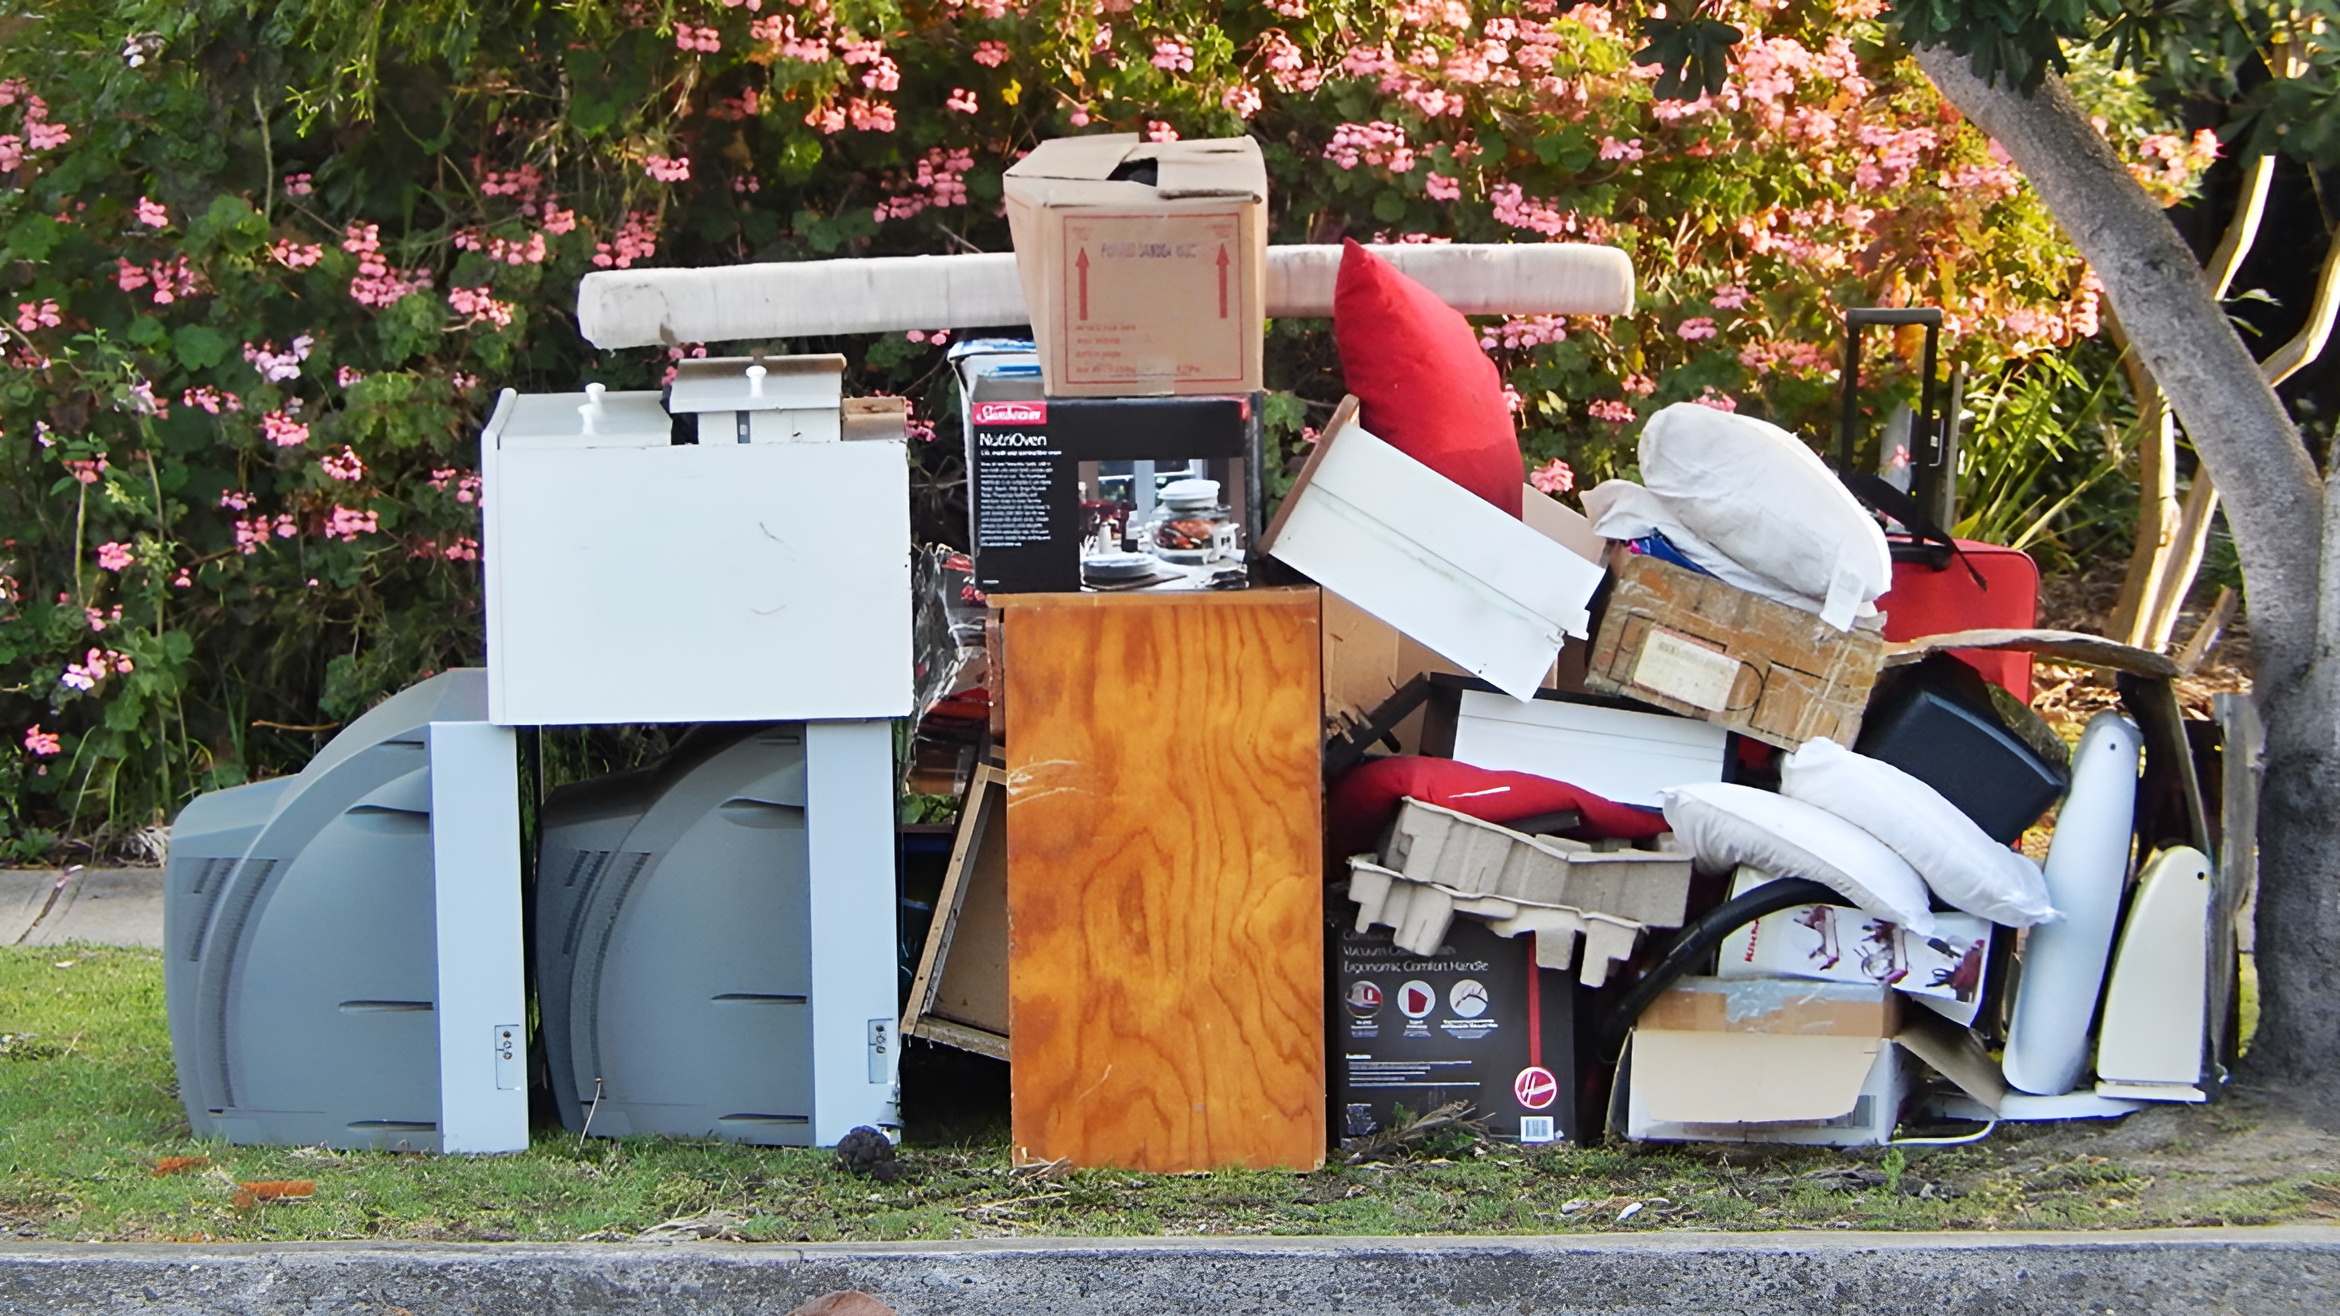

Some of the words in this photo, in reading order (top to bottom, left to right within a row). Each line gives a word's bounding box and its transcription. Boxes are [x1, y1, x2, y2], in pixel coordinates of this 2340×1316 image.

[979, 432, 1047, 447] NutriOven
[1403, 960, 1448, 972] Comfort
[1450, 959, 1489, 971] Handle
